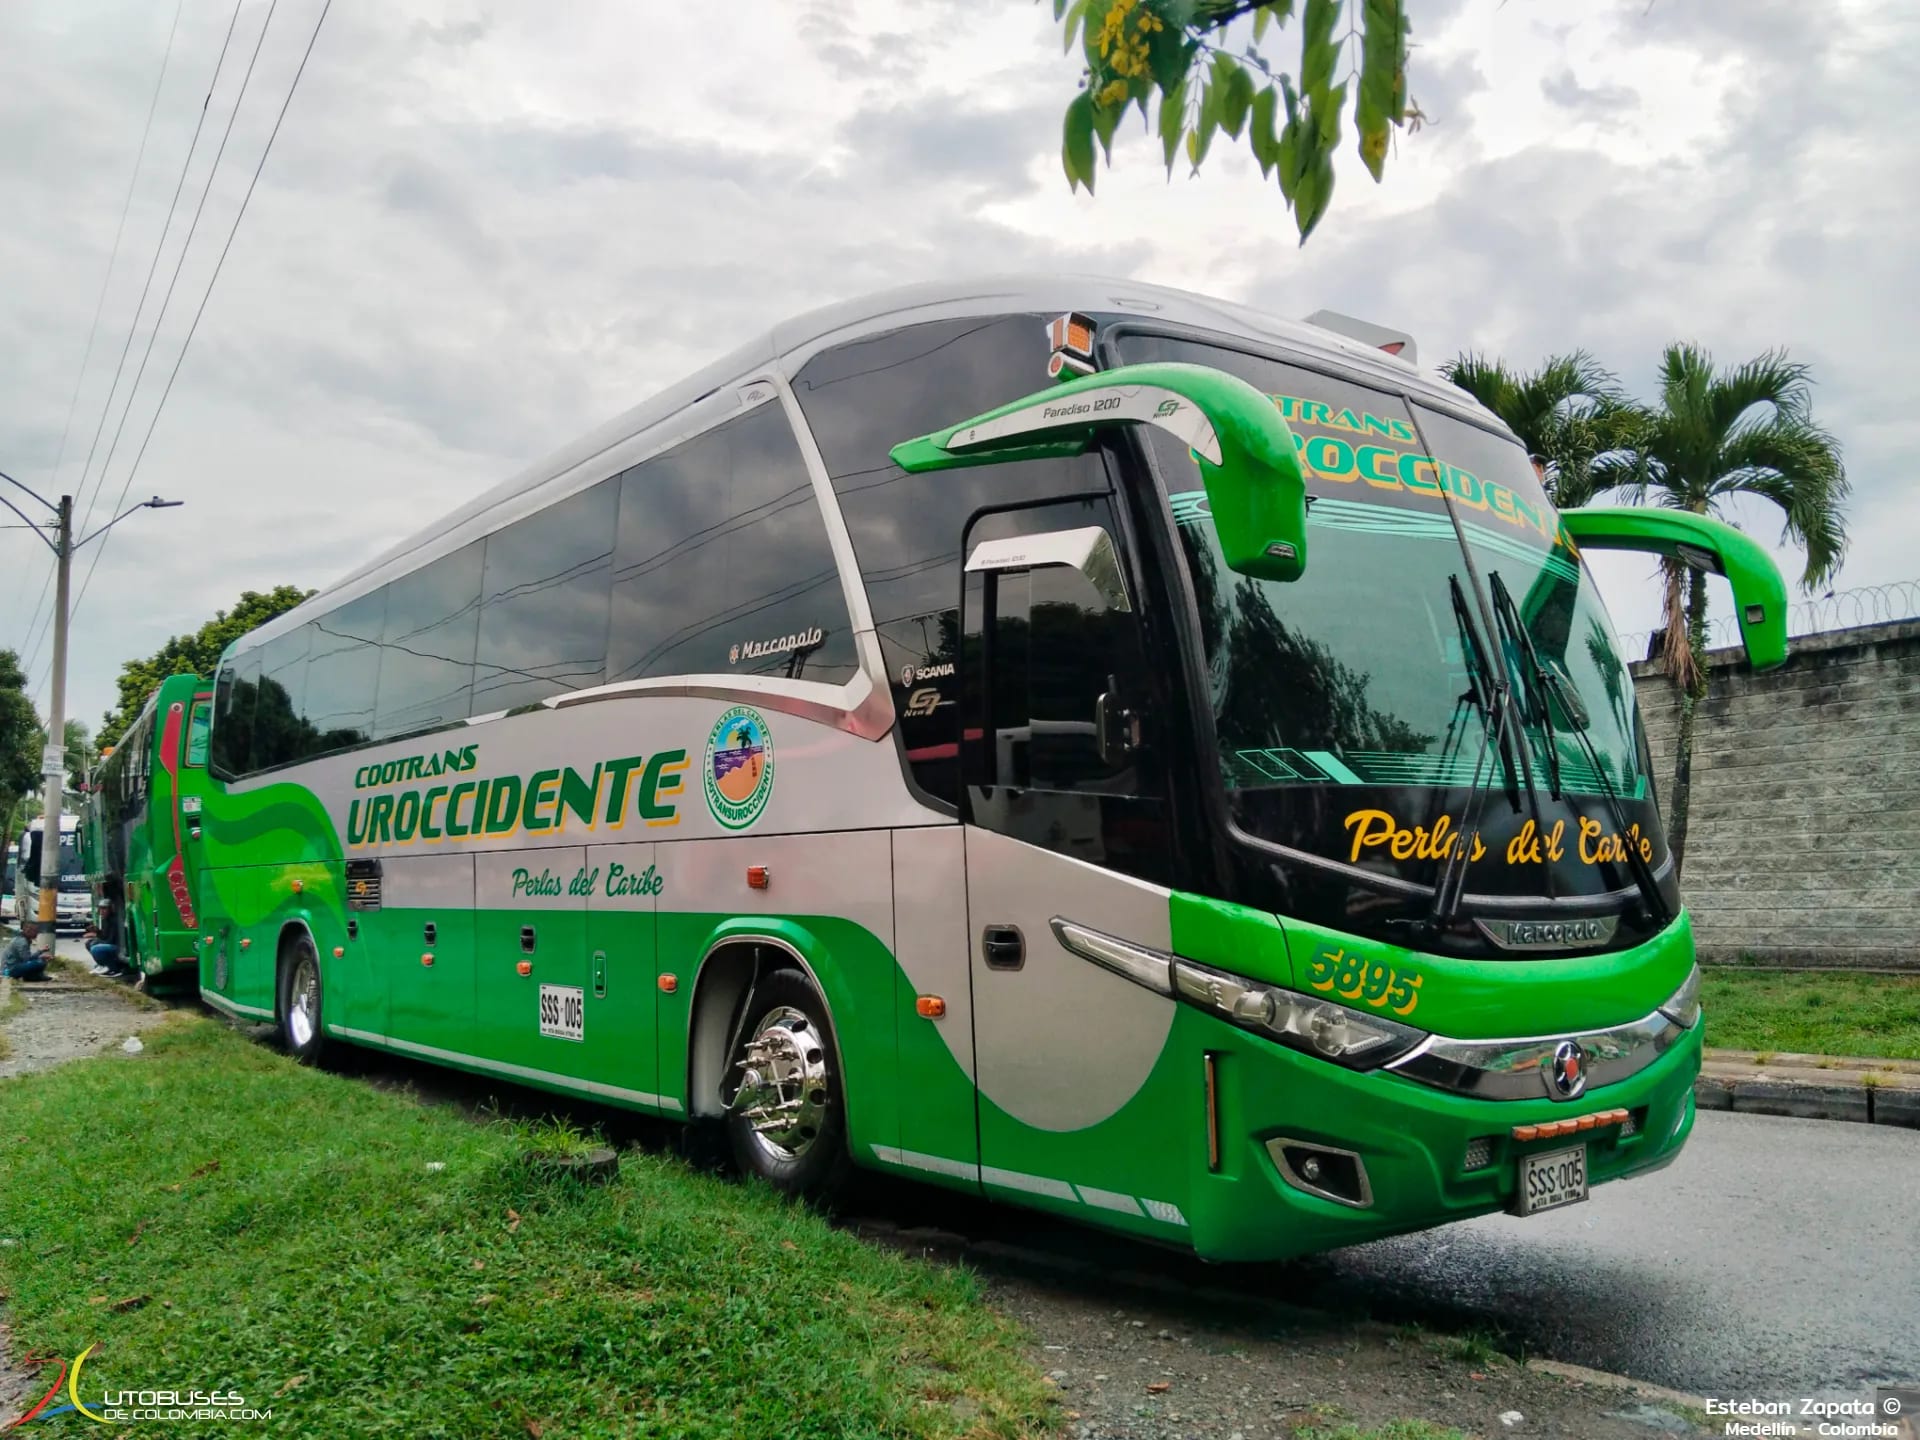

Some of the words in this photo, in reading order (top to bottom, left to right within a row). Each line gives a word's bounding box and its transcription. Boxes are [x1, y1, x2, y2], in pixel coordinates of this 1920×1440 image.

[1043, 403, 1090, 419] Paradiso
[1093, 397, 1120, 412] 1200
[1266, 393, 1416, 444] TRANS
[741, 626, 822, 660] Marcopolo
[915, 663, 955, 680] SCANIA
[732, 708, 746, 717] DEL
[355, 744, 480, 790] COOTRANS
[347, 749, 689, 848] UROCCIDENTE
[512, 867, 562, 899] Perlas
[568, 867, 600, 897] del
[606, 862, 664, 897] Caribe
[1507, 919, 1599, 945] Marcopolo
[1305, 942, 1424, 1015] 5895
